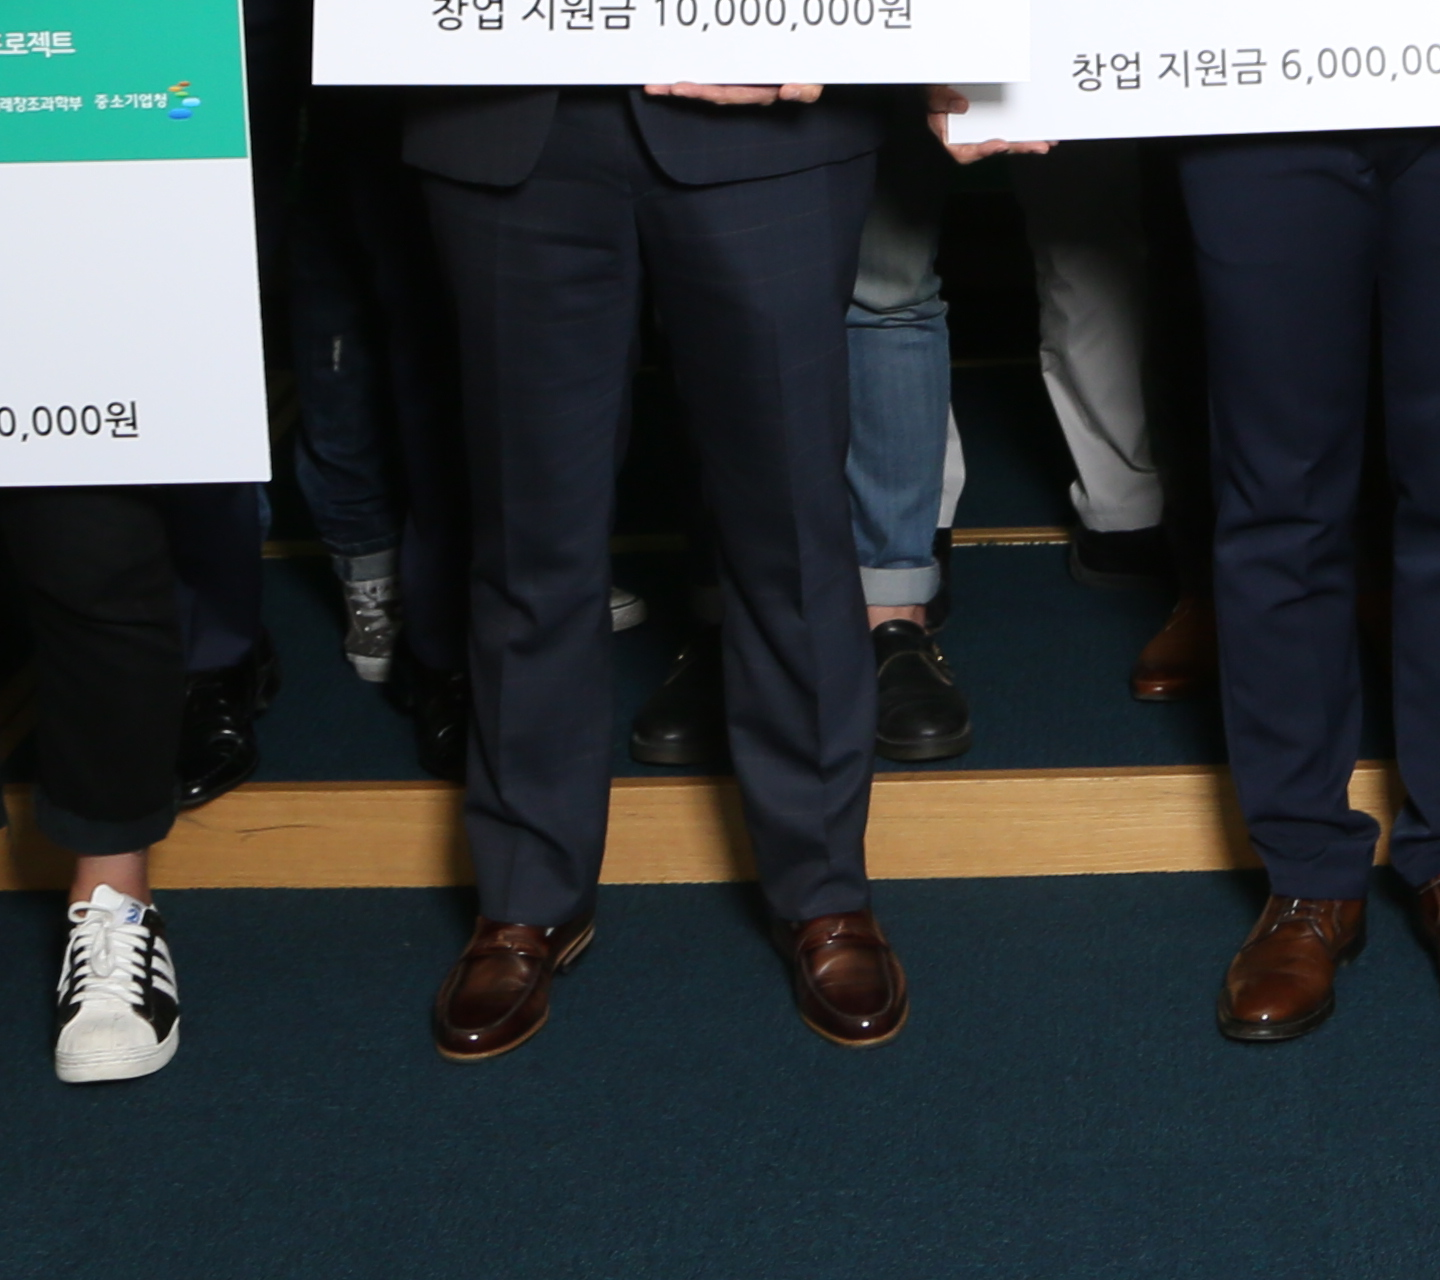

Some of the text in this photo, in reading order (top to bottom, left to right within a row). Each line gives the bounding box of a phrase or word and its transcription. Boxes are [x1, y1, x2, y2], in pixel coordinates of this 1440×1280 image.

[1071, 52, 1143, 92] 창업
[1157, 47, 1268, 89] 지원금
[94, 93, 168, 110] 중소기업청
